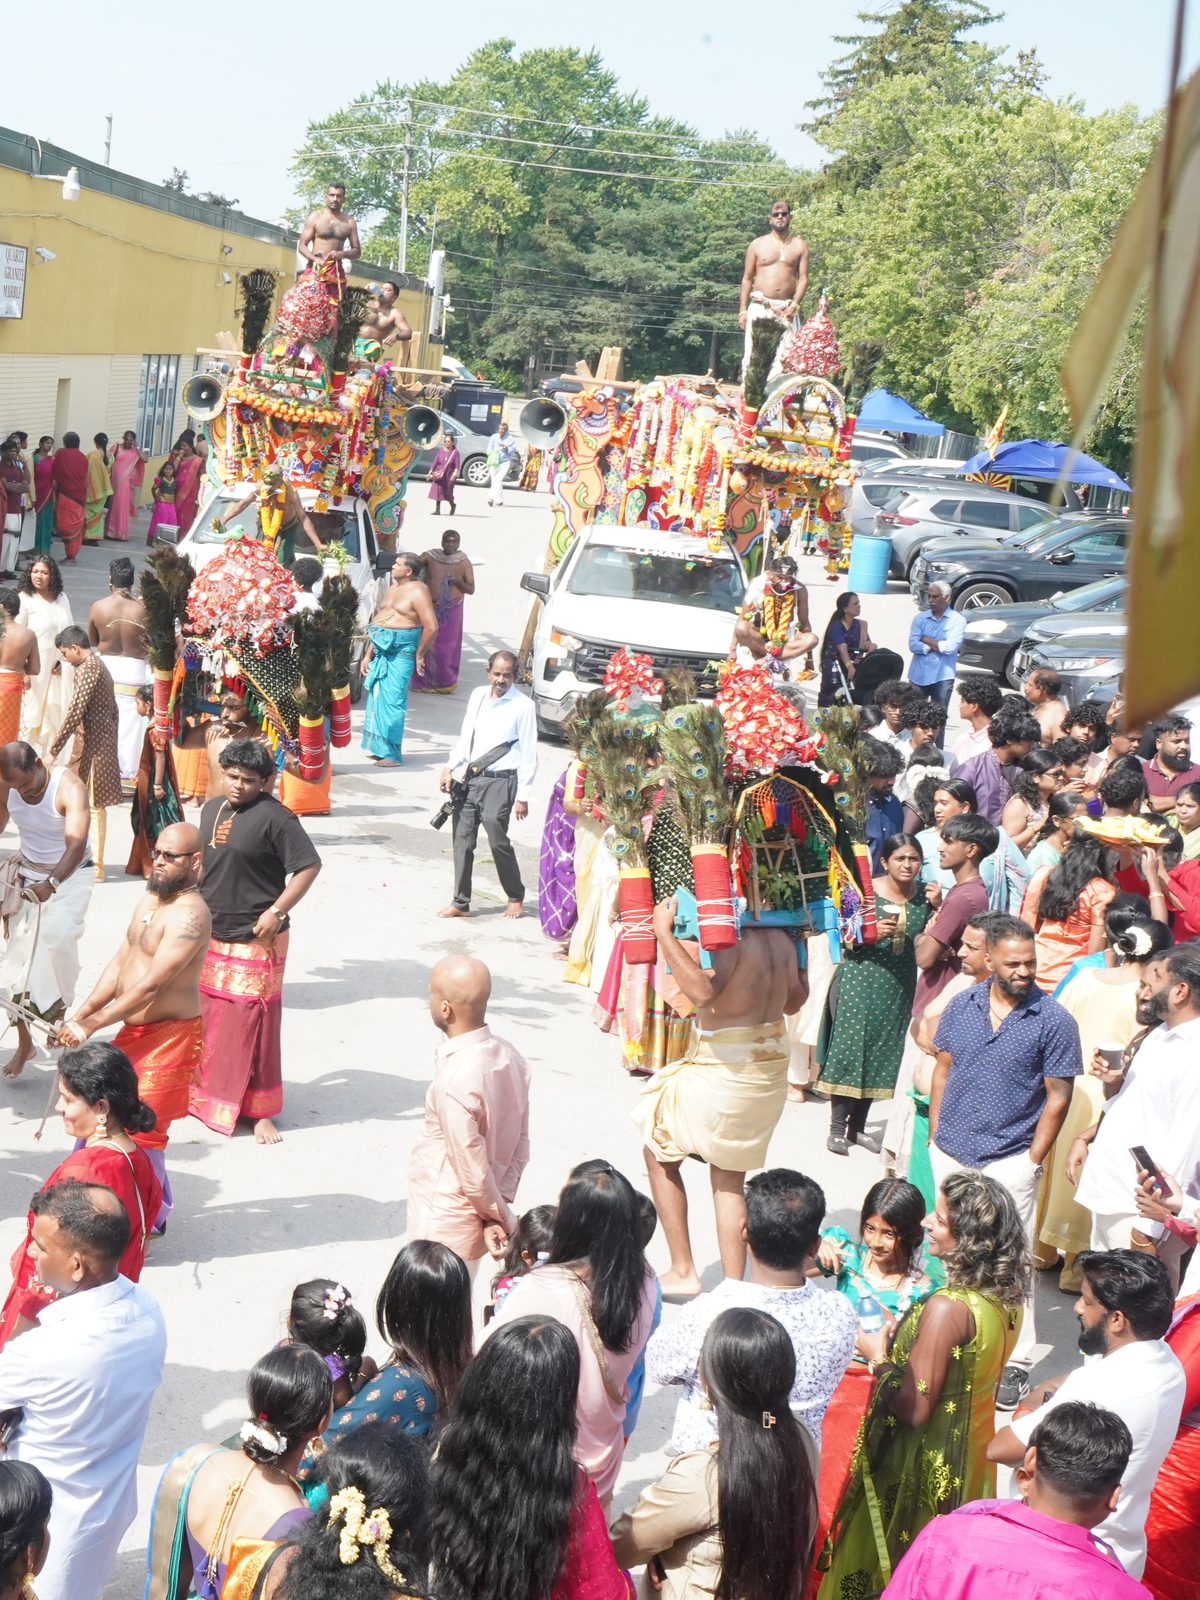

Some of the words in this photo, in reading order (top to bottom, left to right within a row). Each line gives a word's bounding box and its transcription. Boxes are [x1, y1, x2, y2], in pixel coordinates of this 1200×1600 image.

[5, 247, 25, 264] QUARTZ
[4, 266, 25, 281] GRANITE
[3, 284, 22, 299] MARBLE
